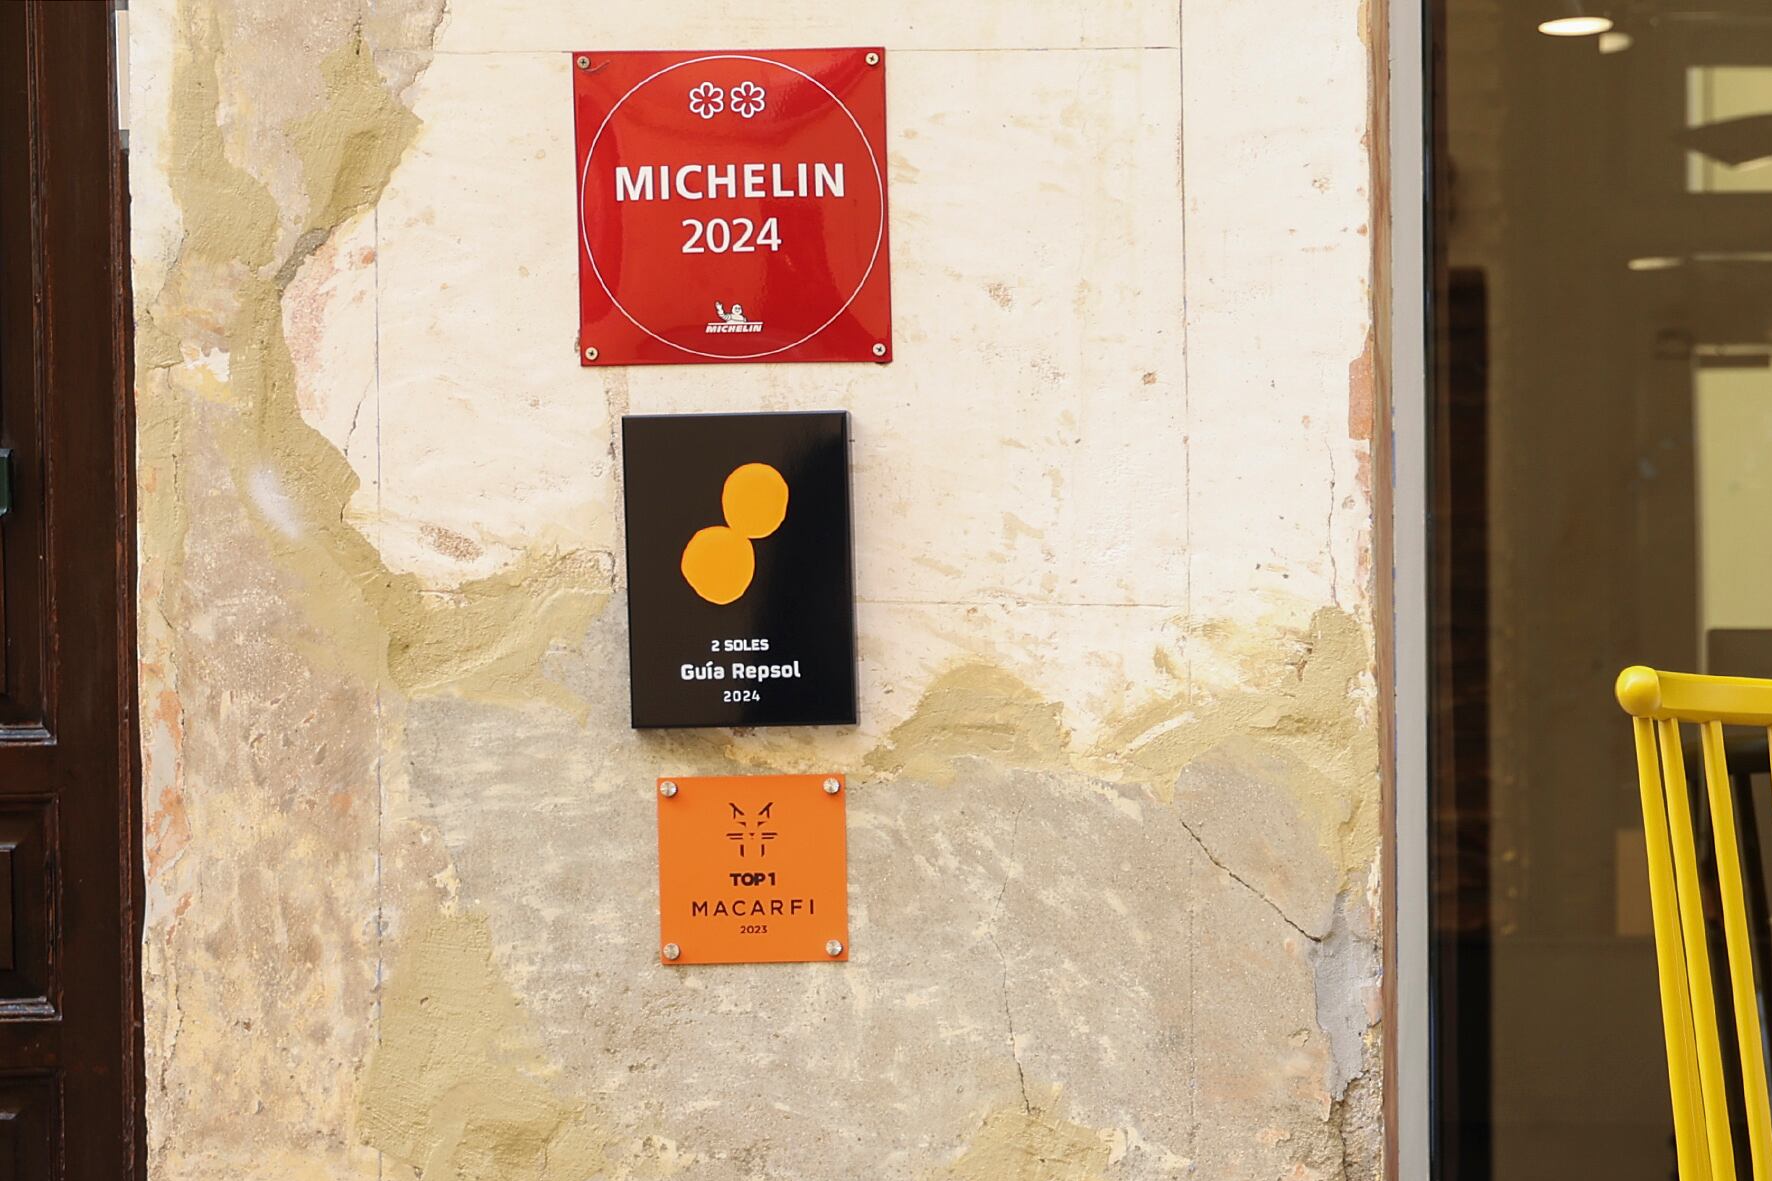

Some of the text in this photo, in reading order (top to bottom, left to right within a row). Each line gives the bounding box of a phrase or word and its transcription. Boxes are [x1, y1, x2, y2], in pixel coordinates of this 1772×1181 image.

[615, 163, 845, 202] MICHELIN
[682, 217, 782, 253] 2024
[705, 325, 763, 333] MICHELIN
[711, 639, 769, 652] 2 SOLES
[681, 660, 800, 682] Guía Repsol
[723, 690, 761, 702] 2024
[729, 872, 776, 886] TOP 1
[692, 899, 814, 916] MACARFI
[740, 925, 768, 934] 2023
